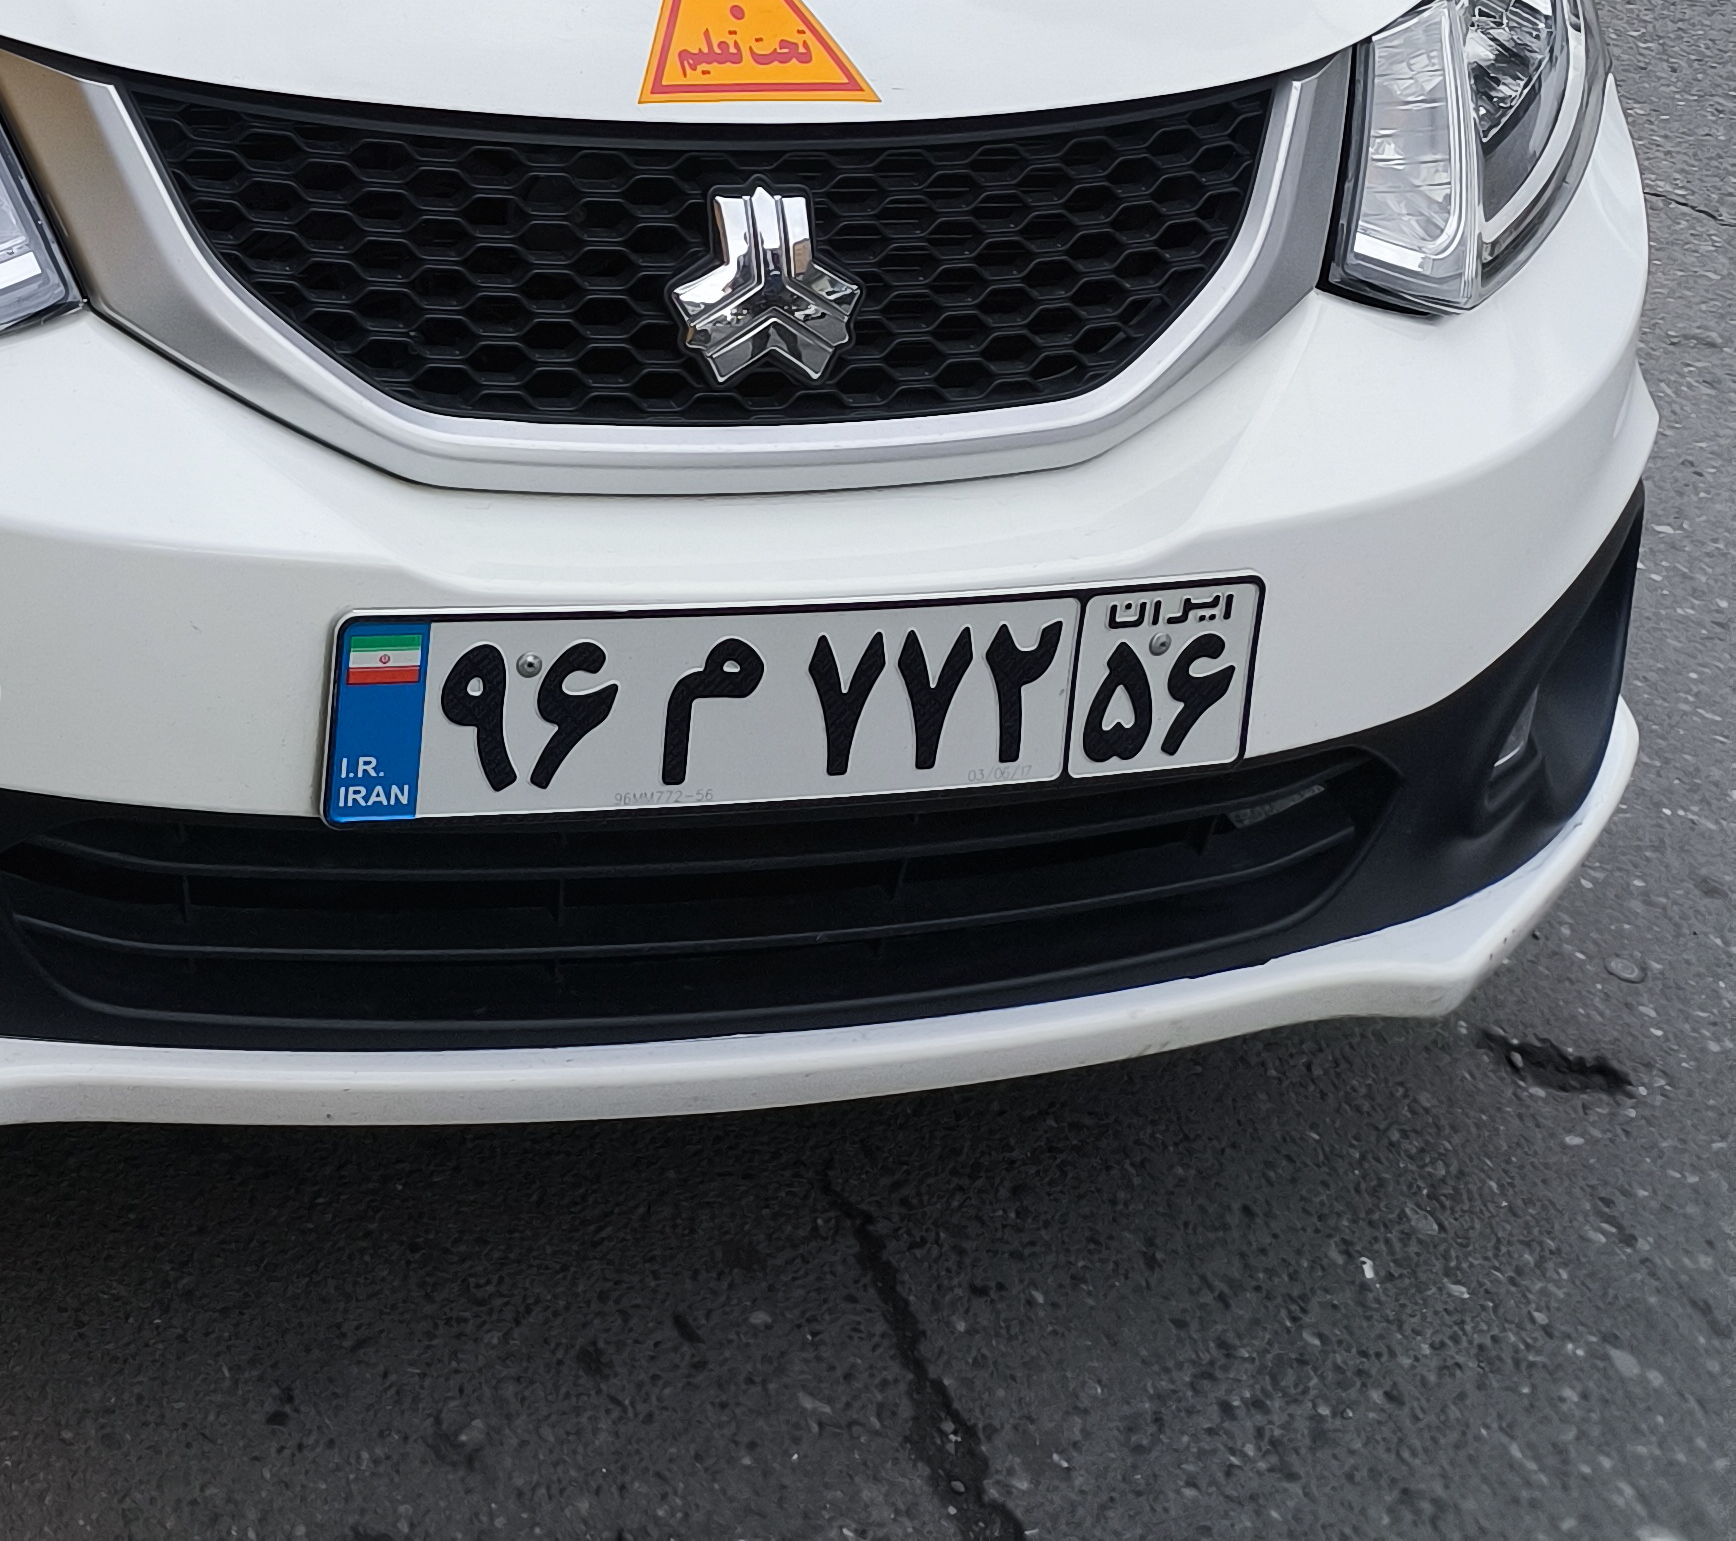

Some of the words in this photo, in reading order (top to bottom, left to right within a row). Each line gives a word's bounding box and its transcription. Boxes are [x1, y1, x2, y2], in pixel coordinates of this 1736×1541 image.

[677, 27, 744, 79] تعلیم
[748, 28, 814, 66] تحت
[1106, 591, 1234, 631] ایران
[440, 640, 620, 792] ۹۶
[660, 637, 765, 786] م
[807, 621, 1064, 776] ۷۷۲
[1080, 633, 1236, 765] ۵۶
[340, 756, 385, 779] I.R.
[338, 784, 409, 808] IRAN
[614, 789, 715, 807] 96MM772-56
